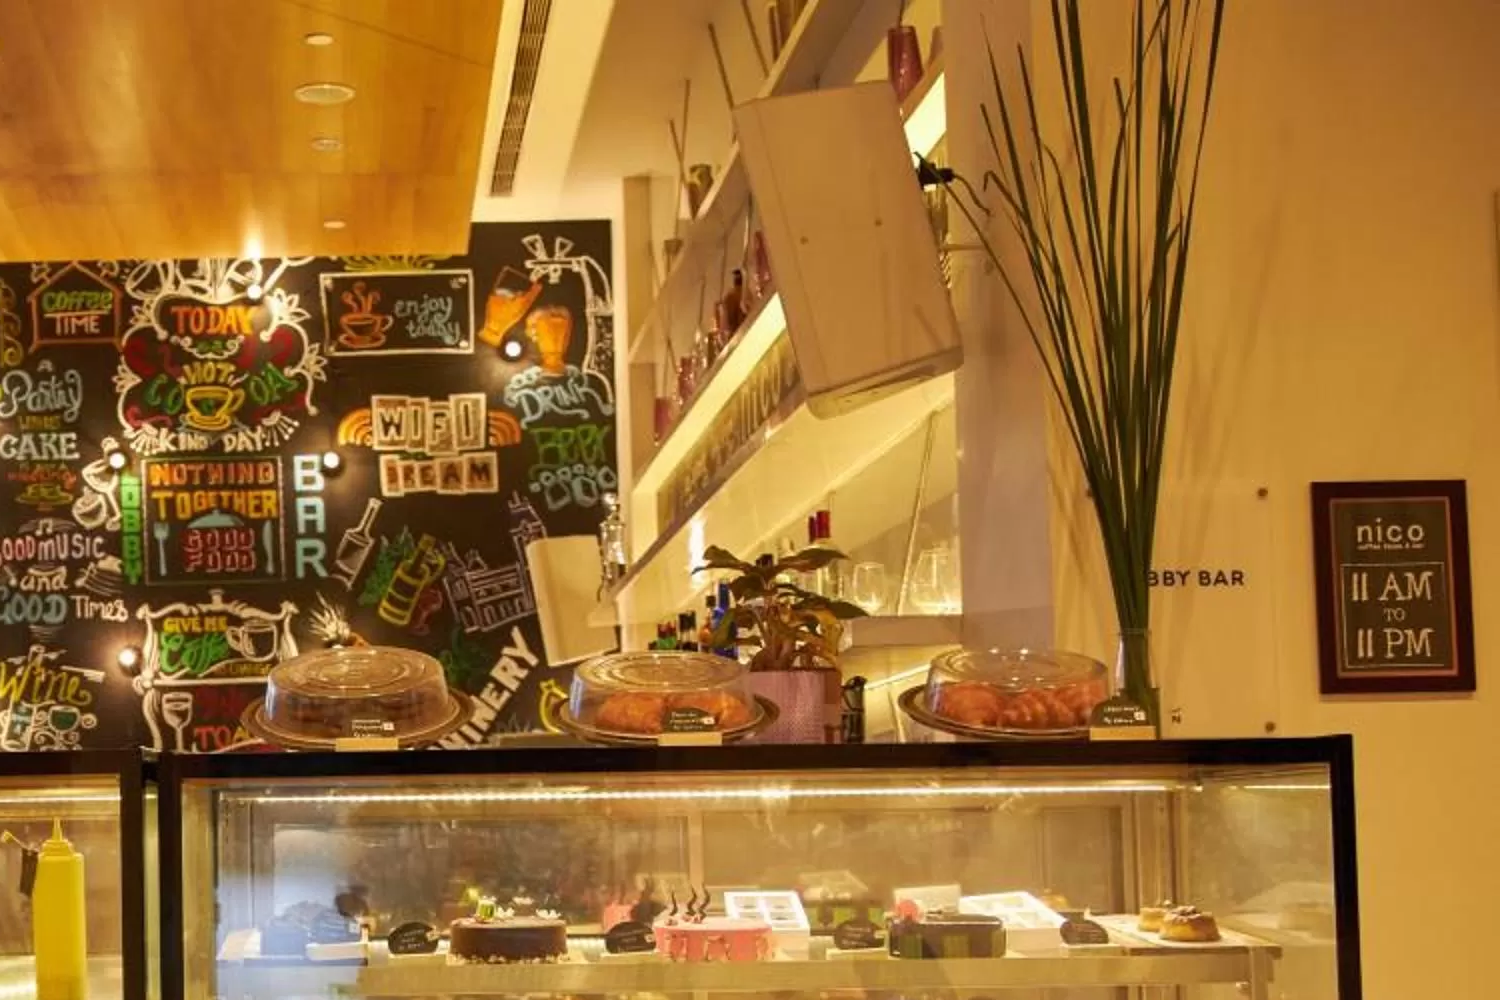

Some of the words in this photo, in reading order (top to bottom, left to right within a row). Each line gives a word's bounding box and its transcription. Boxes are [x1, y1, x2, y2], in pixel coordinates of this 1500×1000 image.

[171, 304, 259, 335] TODAY
[394, 293, 454, 325] enjoy
[54, 314, 102, 336] TIME
[182, 361, 237, 385] HOT
[151, 490, 278, 521] TOGETHER
[293, 454, 329, 579] BAR
[1356, 517, 1425, 542] nico
[1147, 569, 1191, 586] BBY
[1198, 569, 1244, 586] BAR
[1378, 571, 1434, 601] AM
[1383, 607, 1407, 622] TO
[1382, 628, 1436, 659] PM
